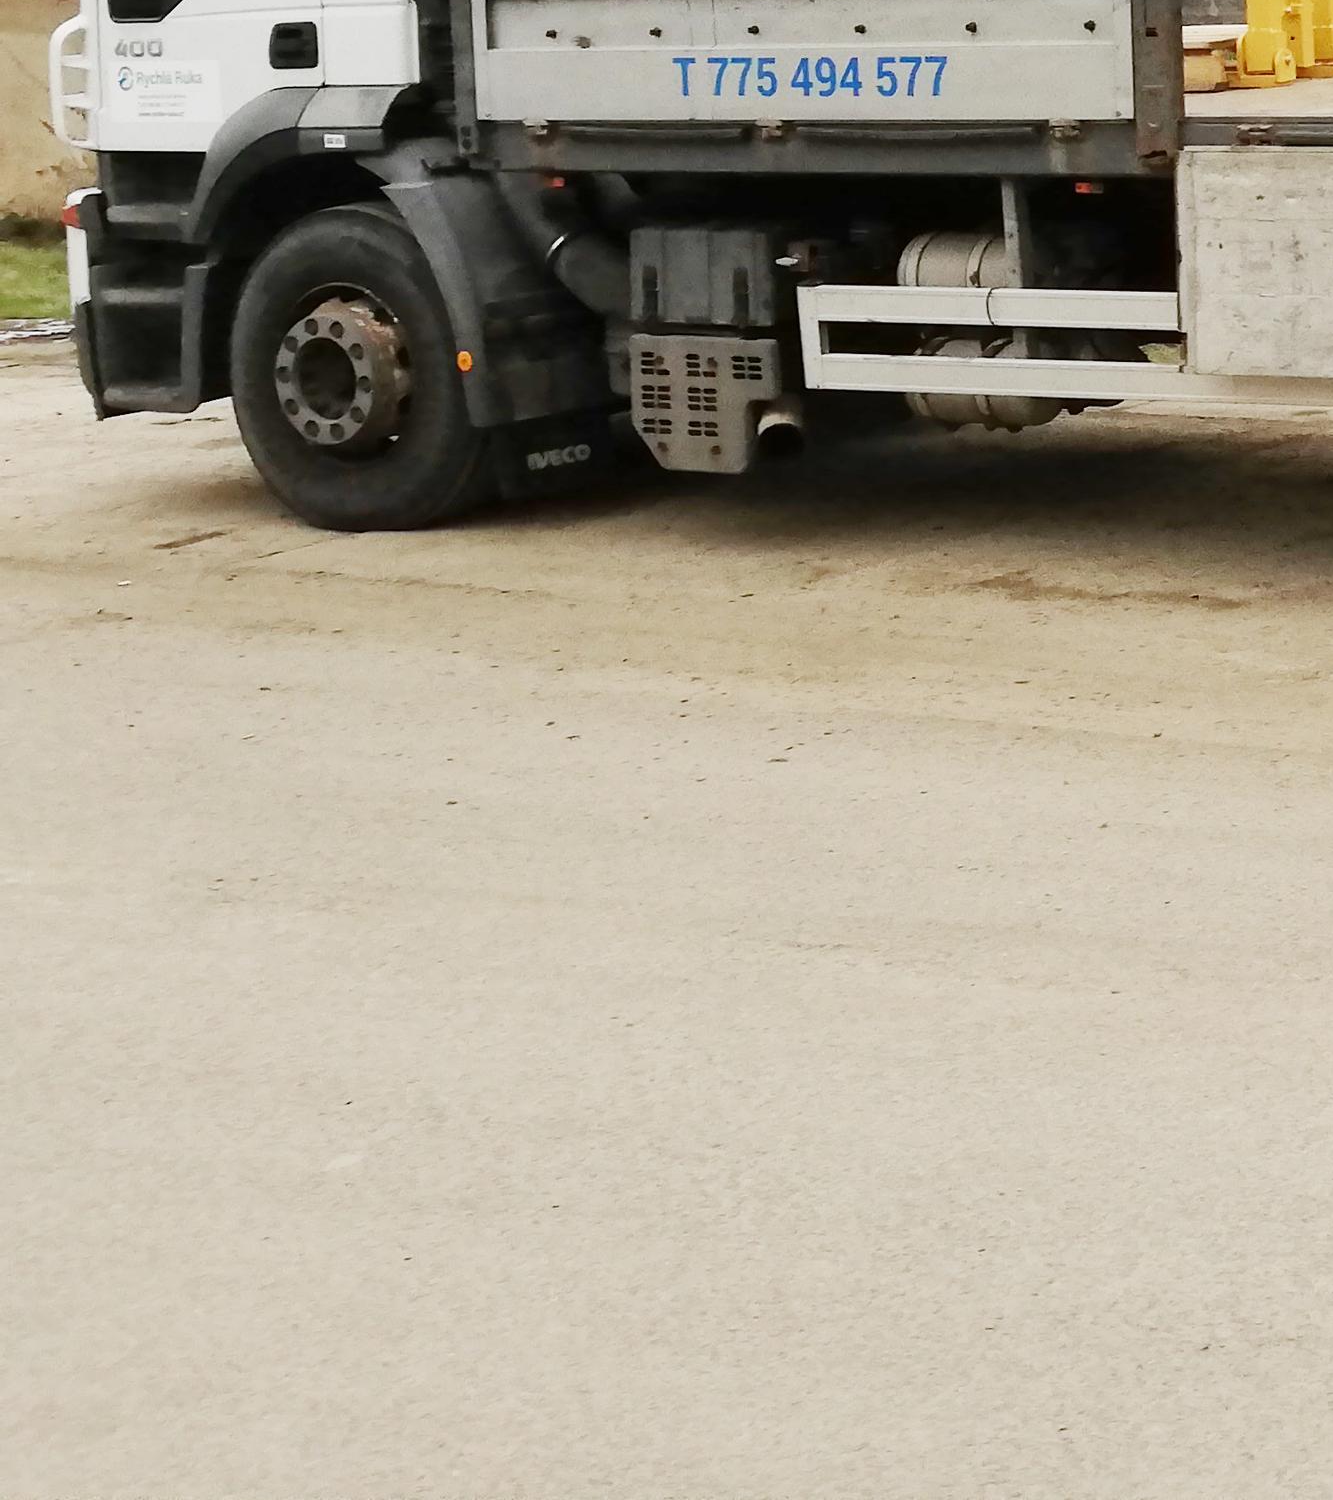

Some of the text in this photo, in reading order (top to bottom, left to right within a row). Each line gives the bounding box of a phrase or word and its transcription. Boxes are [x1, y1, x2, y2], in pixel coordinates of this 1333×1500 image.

[114, 38, 163, 58] 400
[672, 56, 948, 97] T 775 494 577
[526, 443, 592, 471] IVECO
